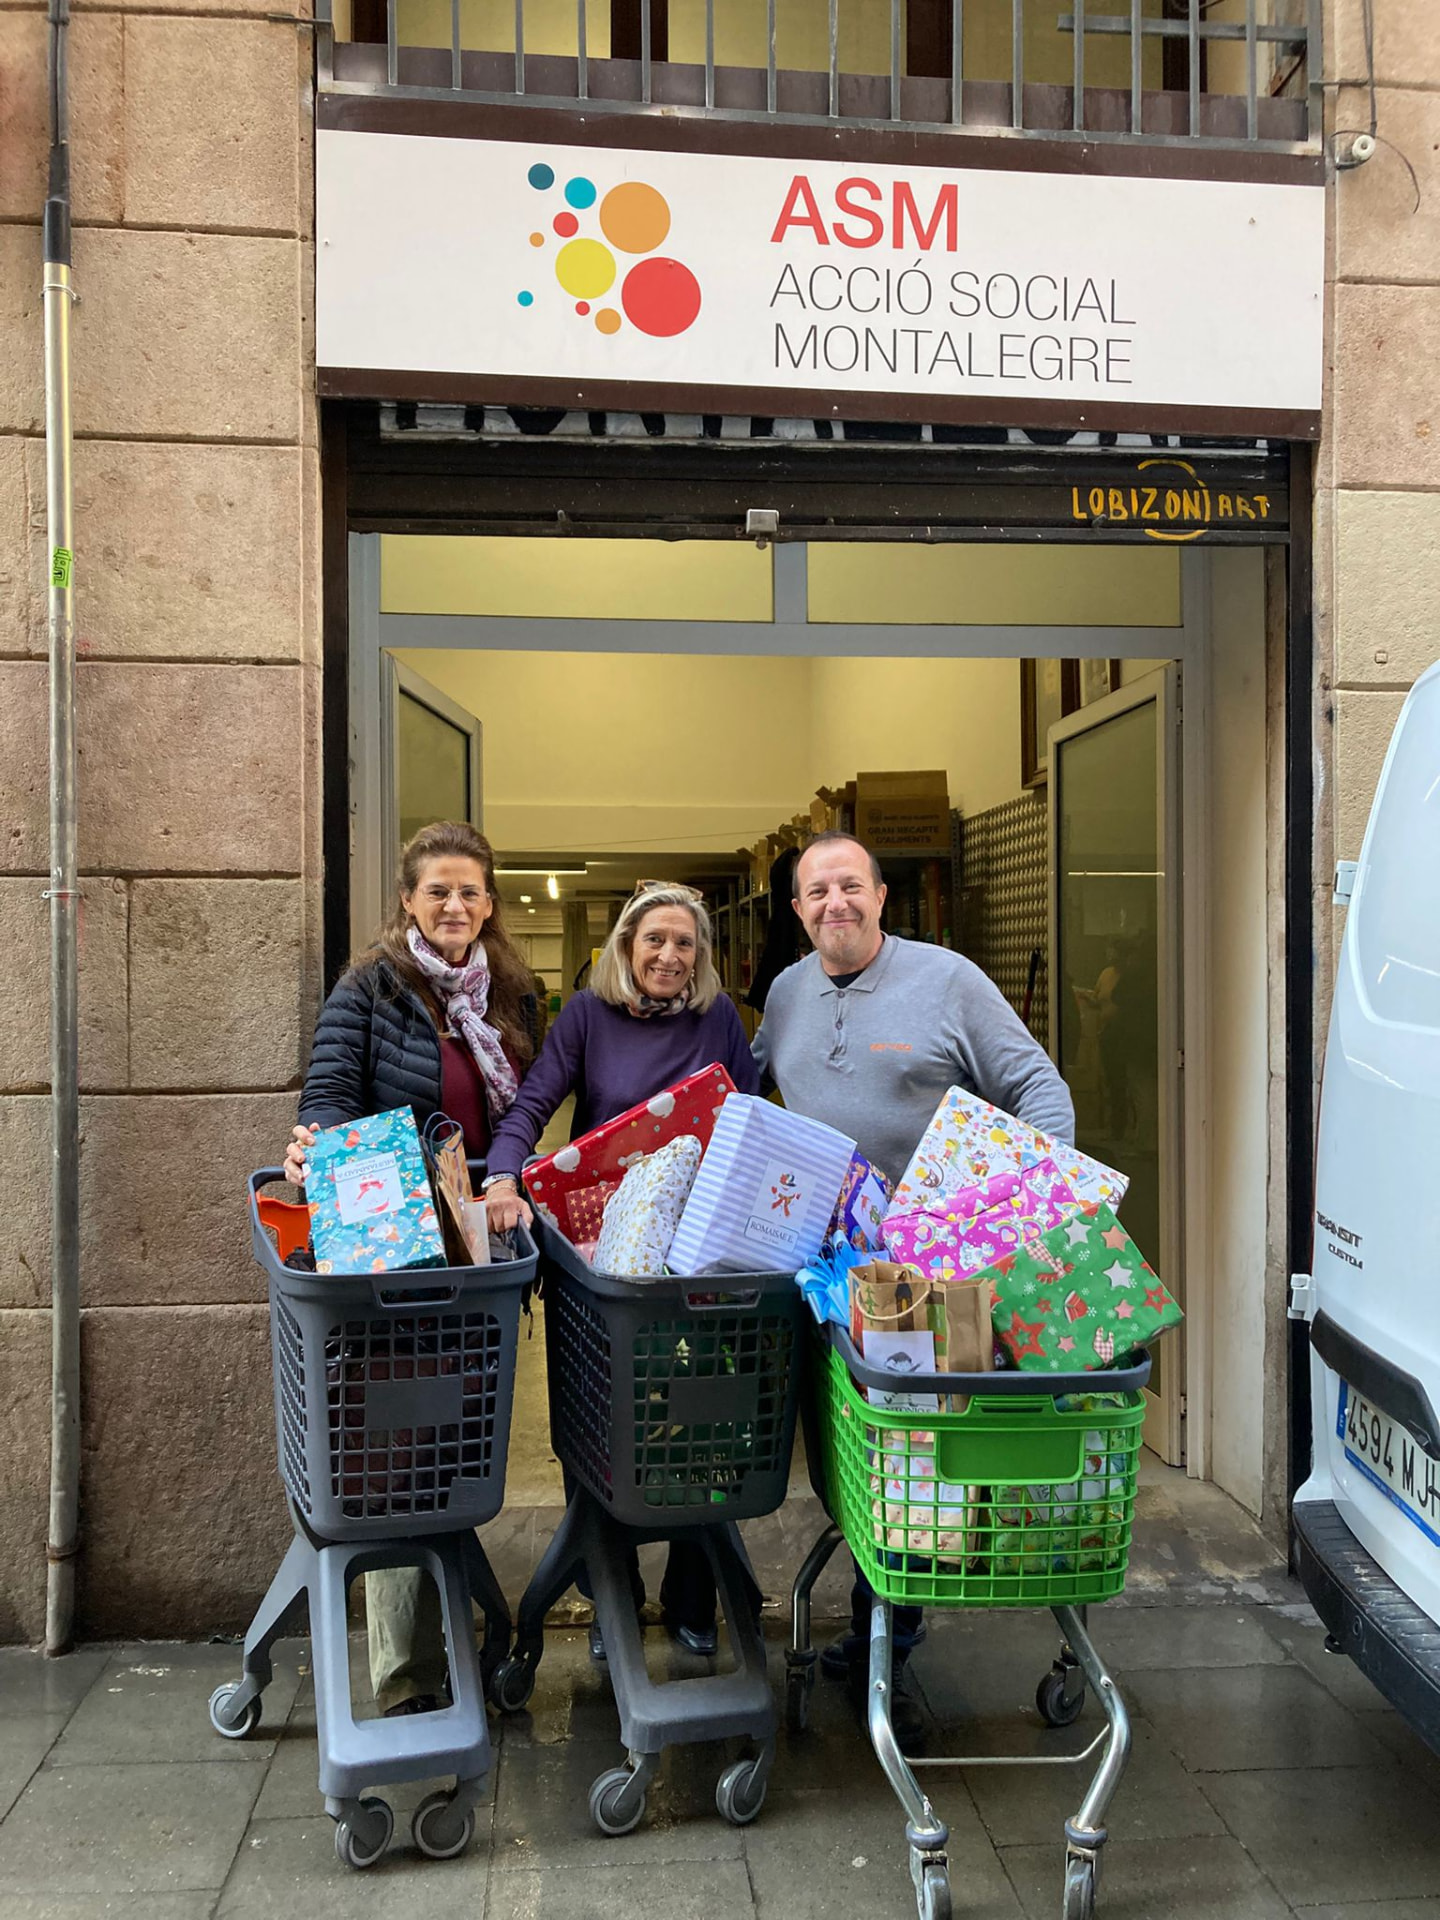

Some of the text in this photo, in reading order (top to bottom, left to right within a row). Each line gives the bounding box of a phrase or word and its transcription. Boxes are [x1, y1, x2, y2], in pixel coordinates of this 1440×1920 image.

[770, 175, 958, 252] ASM
[770, 258, 1136, 324] ACCIÓ SOCIAL
[774, 322, 1133, 384] MONTALEGRE
[1218, 494, 1270, 519] ART
[1347, 1395, 1395, 1478] 4594
